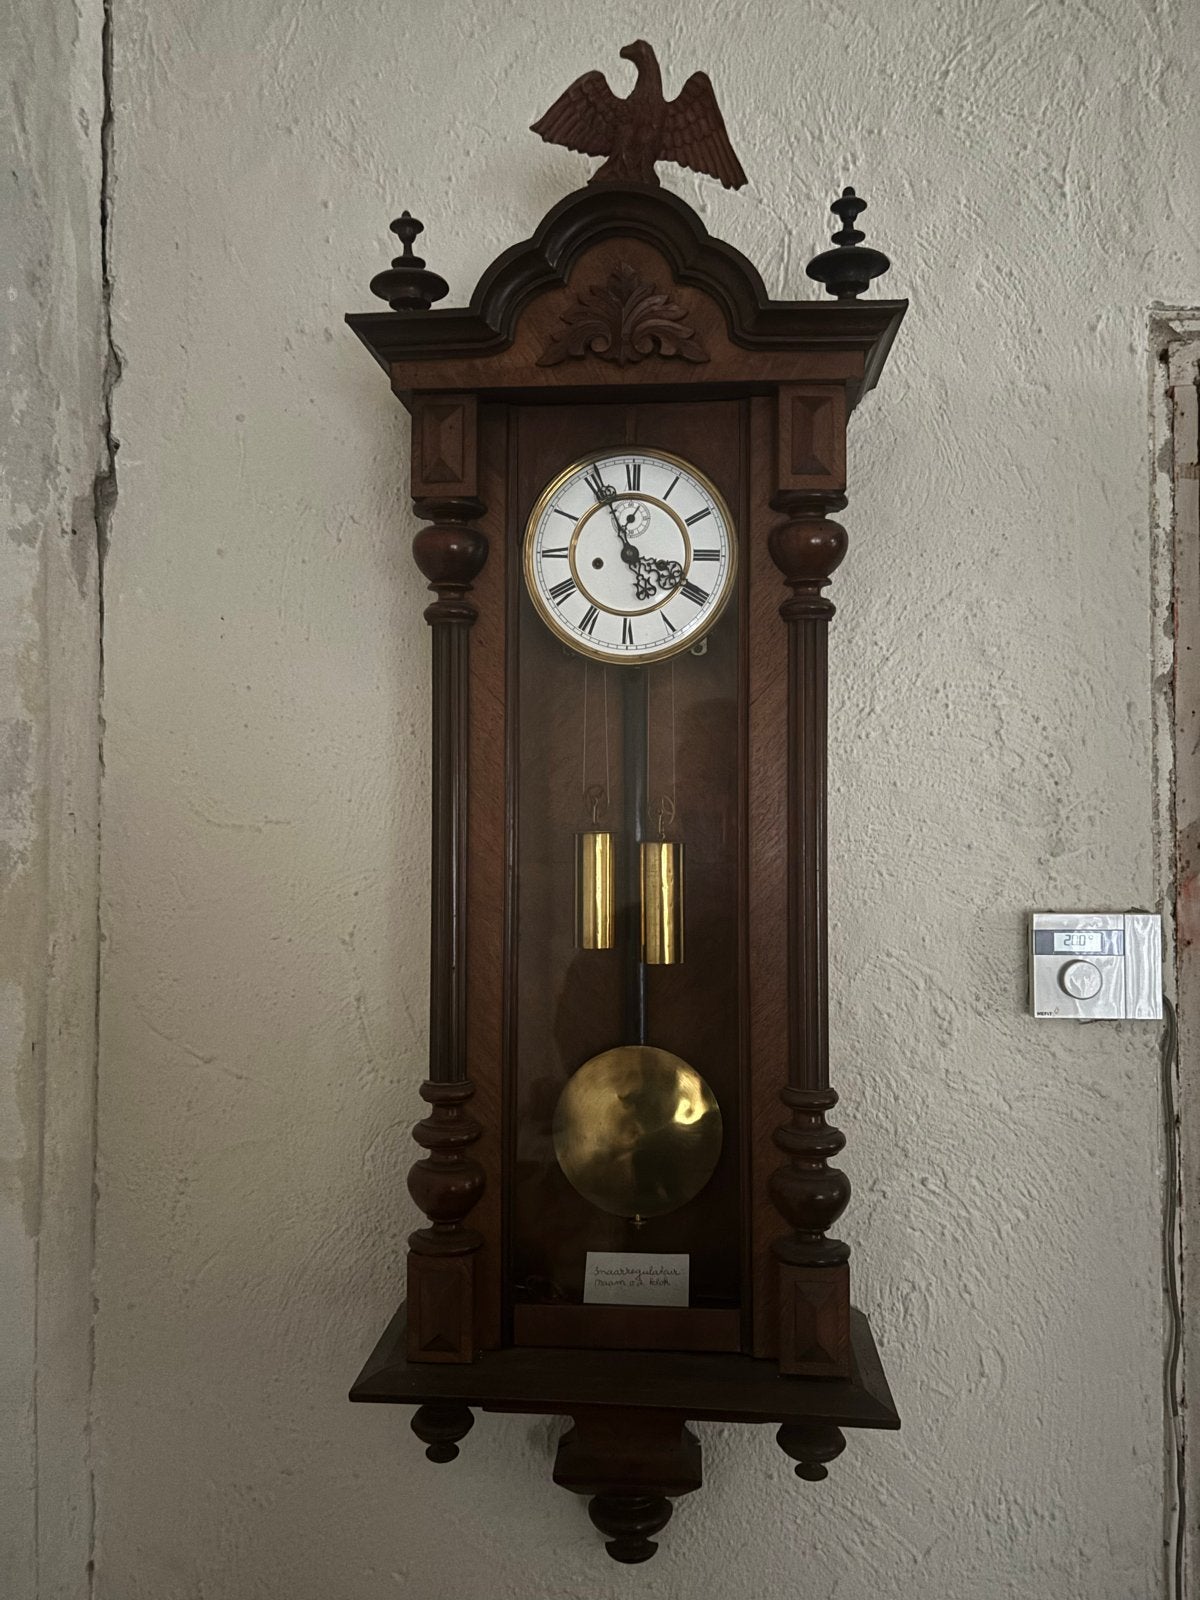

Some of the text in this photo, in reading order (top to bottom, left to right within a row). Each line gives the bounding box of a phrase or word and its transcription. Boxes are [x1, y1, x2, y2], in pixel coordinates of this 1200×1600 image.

[624, 464, 641, 491] XII
[662, 475, 680, 501] I
[684, 507, 712, 527] II
[541, 546, 569, 559] IX
[692, 549, 721, 562] III
[549, 577, 577, 607] VIII
[578, 605, 600, 636] VII
[621, 617, 634, 645] VI
[659, 609, 677, 636] V
